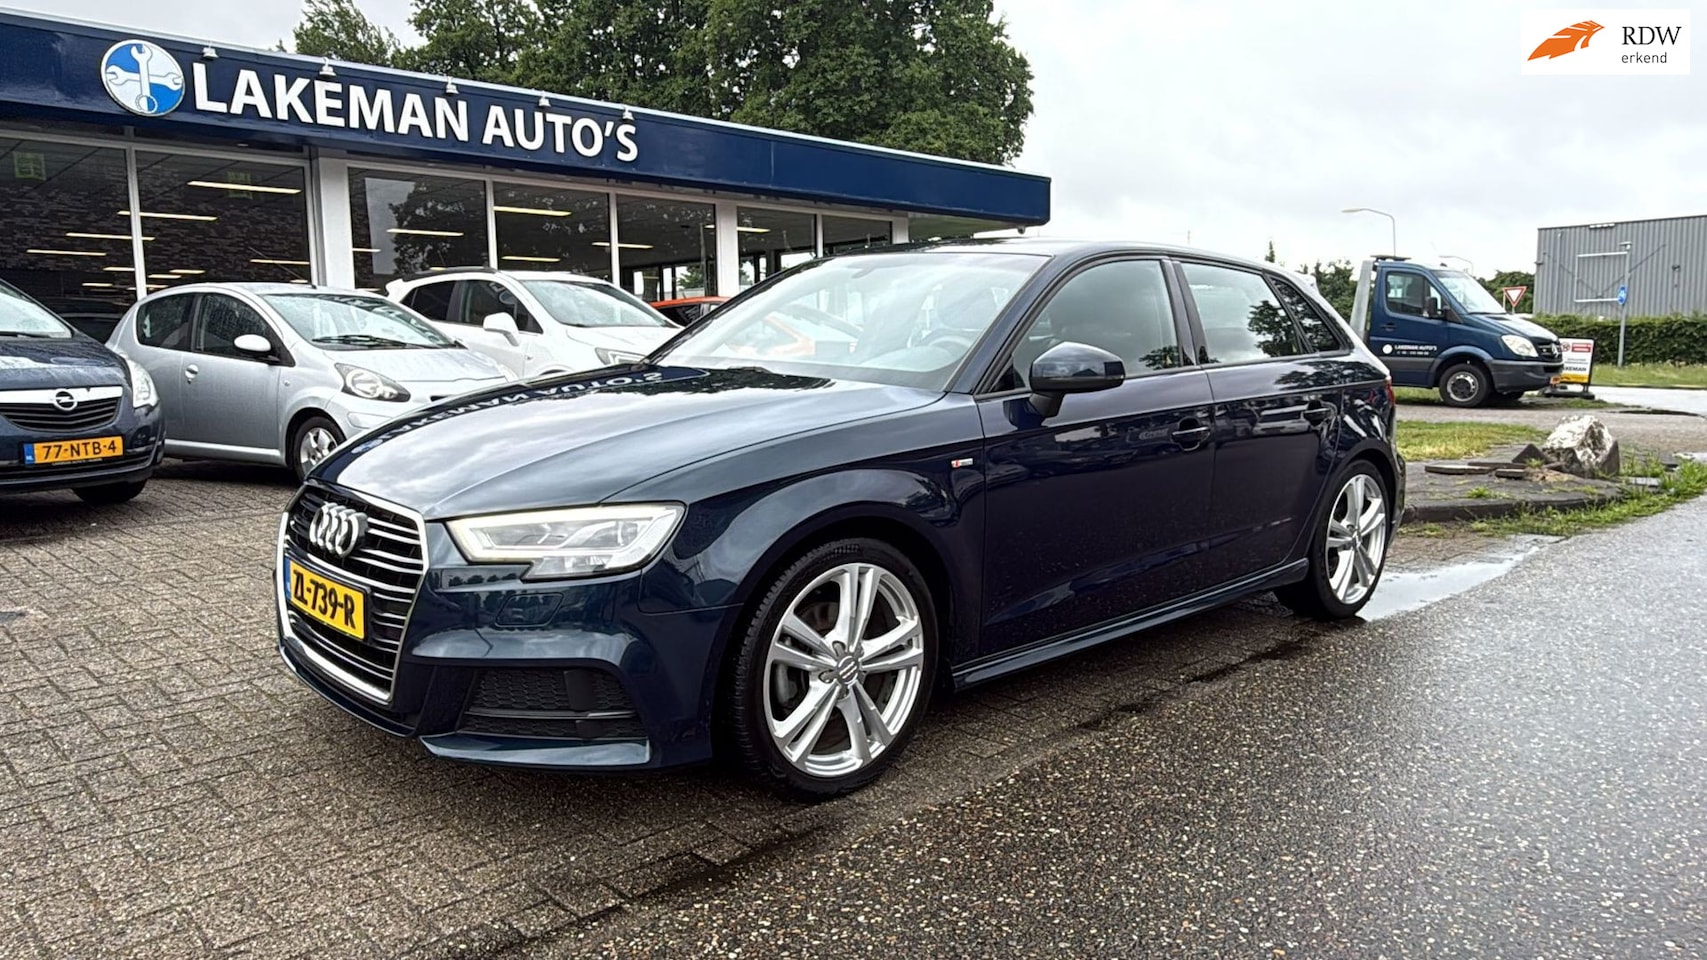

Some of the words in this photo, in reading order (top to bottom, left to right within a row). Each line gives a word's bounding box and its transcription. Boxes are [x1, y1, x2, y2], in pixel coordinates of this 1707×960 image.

[192, 62, 469, 142] LAKEMAN
[482, 104, 639, 162] AUTO'S
[42, 440, 116, 460] 77-NTB-4
[293, 569, 356, 629] ZL-739-R
